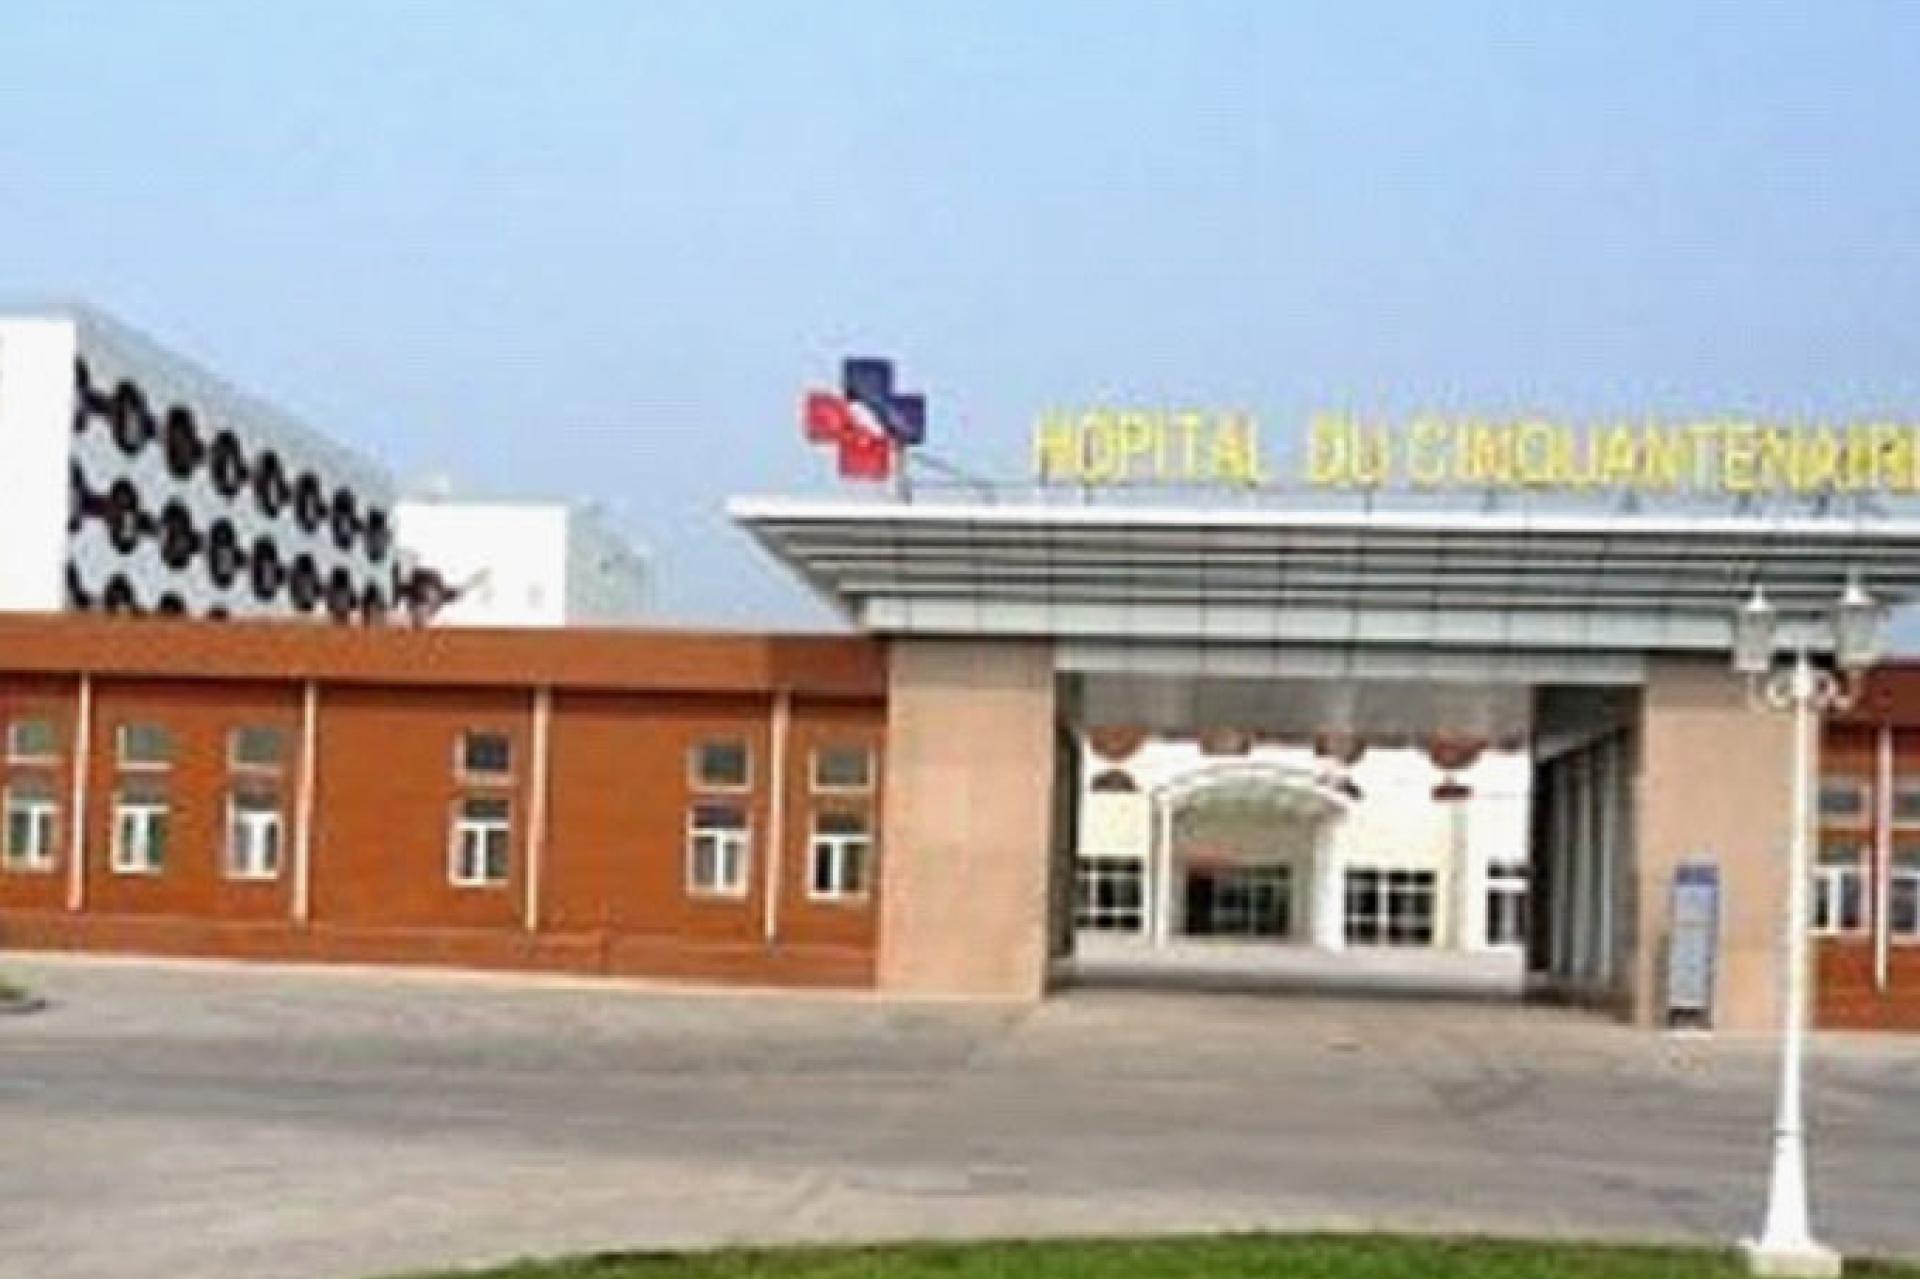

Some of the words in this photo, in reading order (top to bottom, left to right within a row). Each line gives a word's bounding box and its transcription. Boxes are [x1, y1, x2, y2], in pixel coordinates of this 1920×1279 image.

[1034, 411, 1262, 484] HOPITAL
[1308, 415, 1389, 487] DU
[1409, 418, 1920, 491] CINQUANTENAIR
